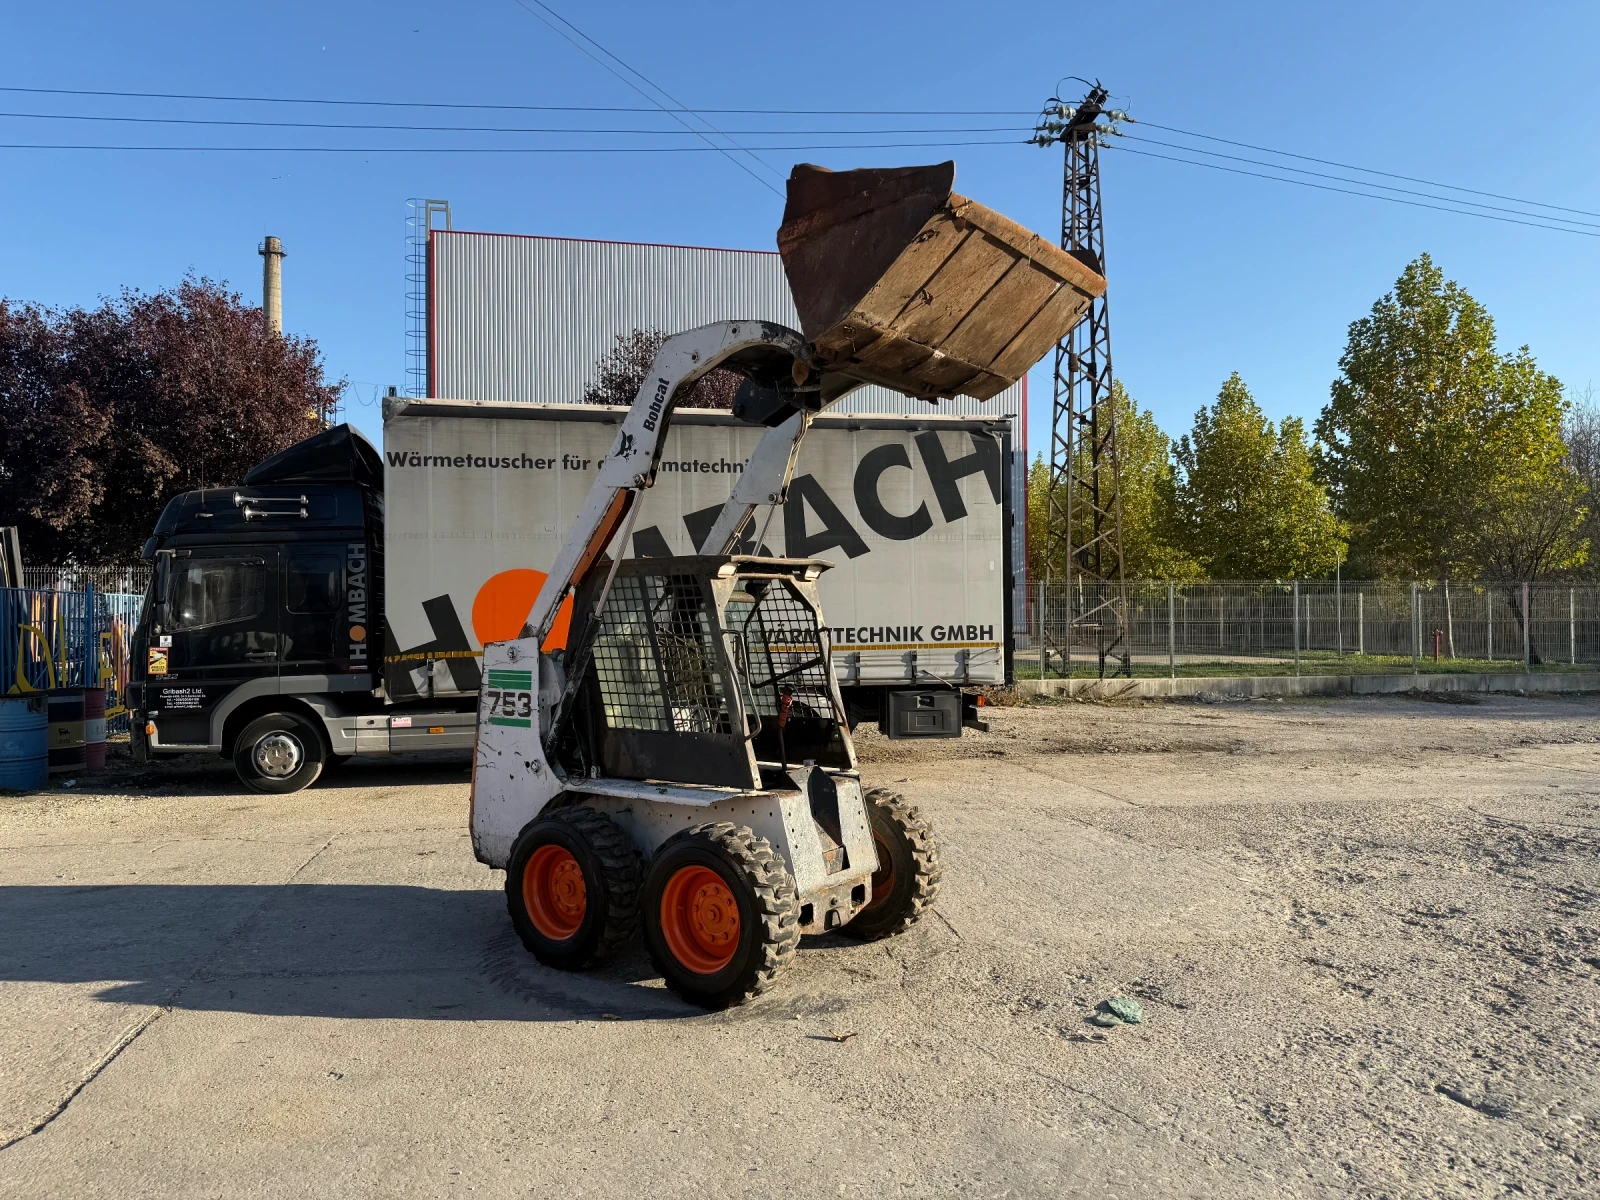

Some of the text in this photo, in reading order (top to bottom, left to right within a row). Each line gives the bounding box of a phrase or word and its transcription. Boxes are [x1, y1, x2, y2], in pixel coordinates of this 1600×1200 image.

[643, 377, 670, 432] Bobcat
[386, 451, 556, 470] Wärmetauscher
[562, 454, 590, 470] für
[658, 458, 750, 473] matechn
[384, 428, 1003, 704] HOBACH
[348, 543, 367, 660] HOMBACH
[752, 623, 993, 645] WÄRMTECHNIK GMBH
[488, 690, 532, 718] 753
